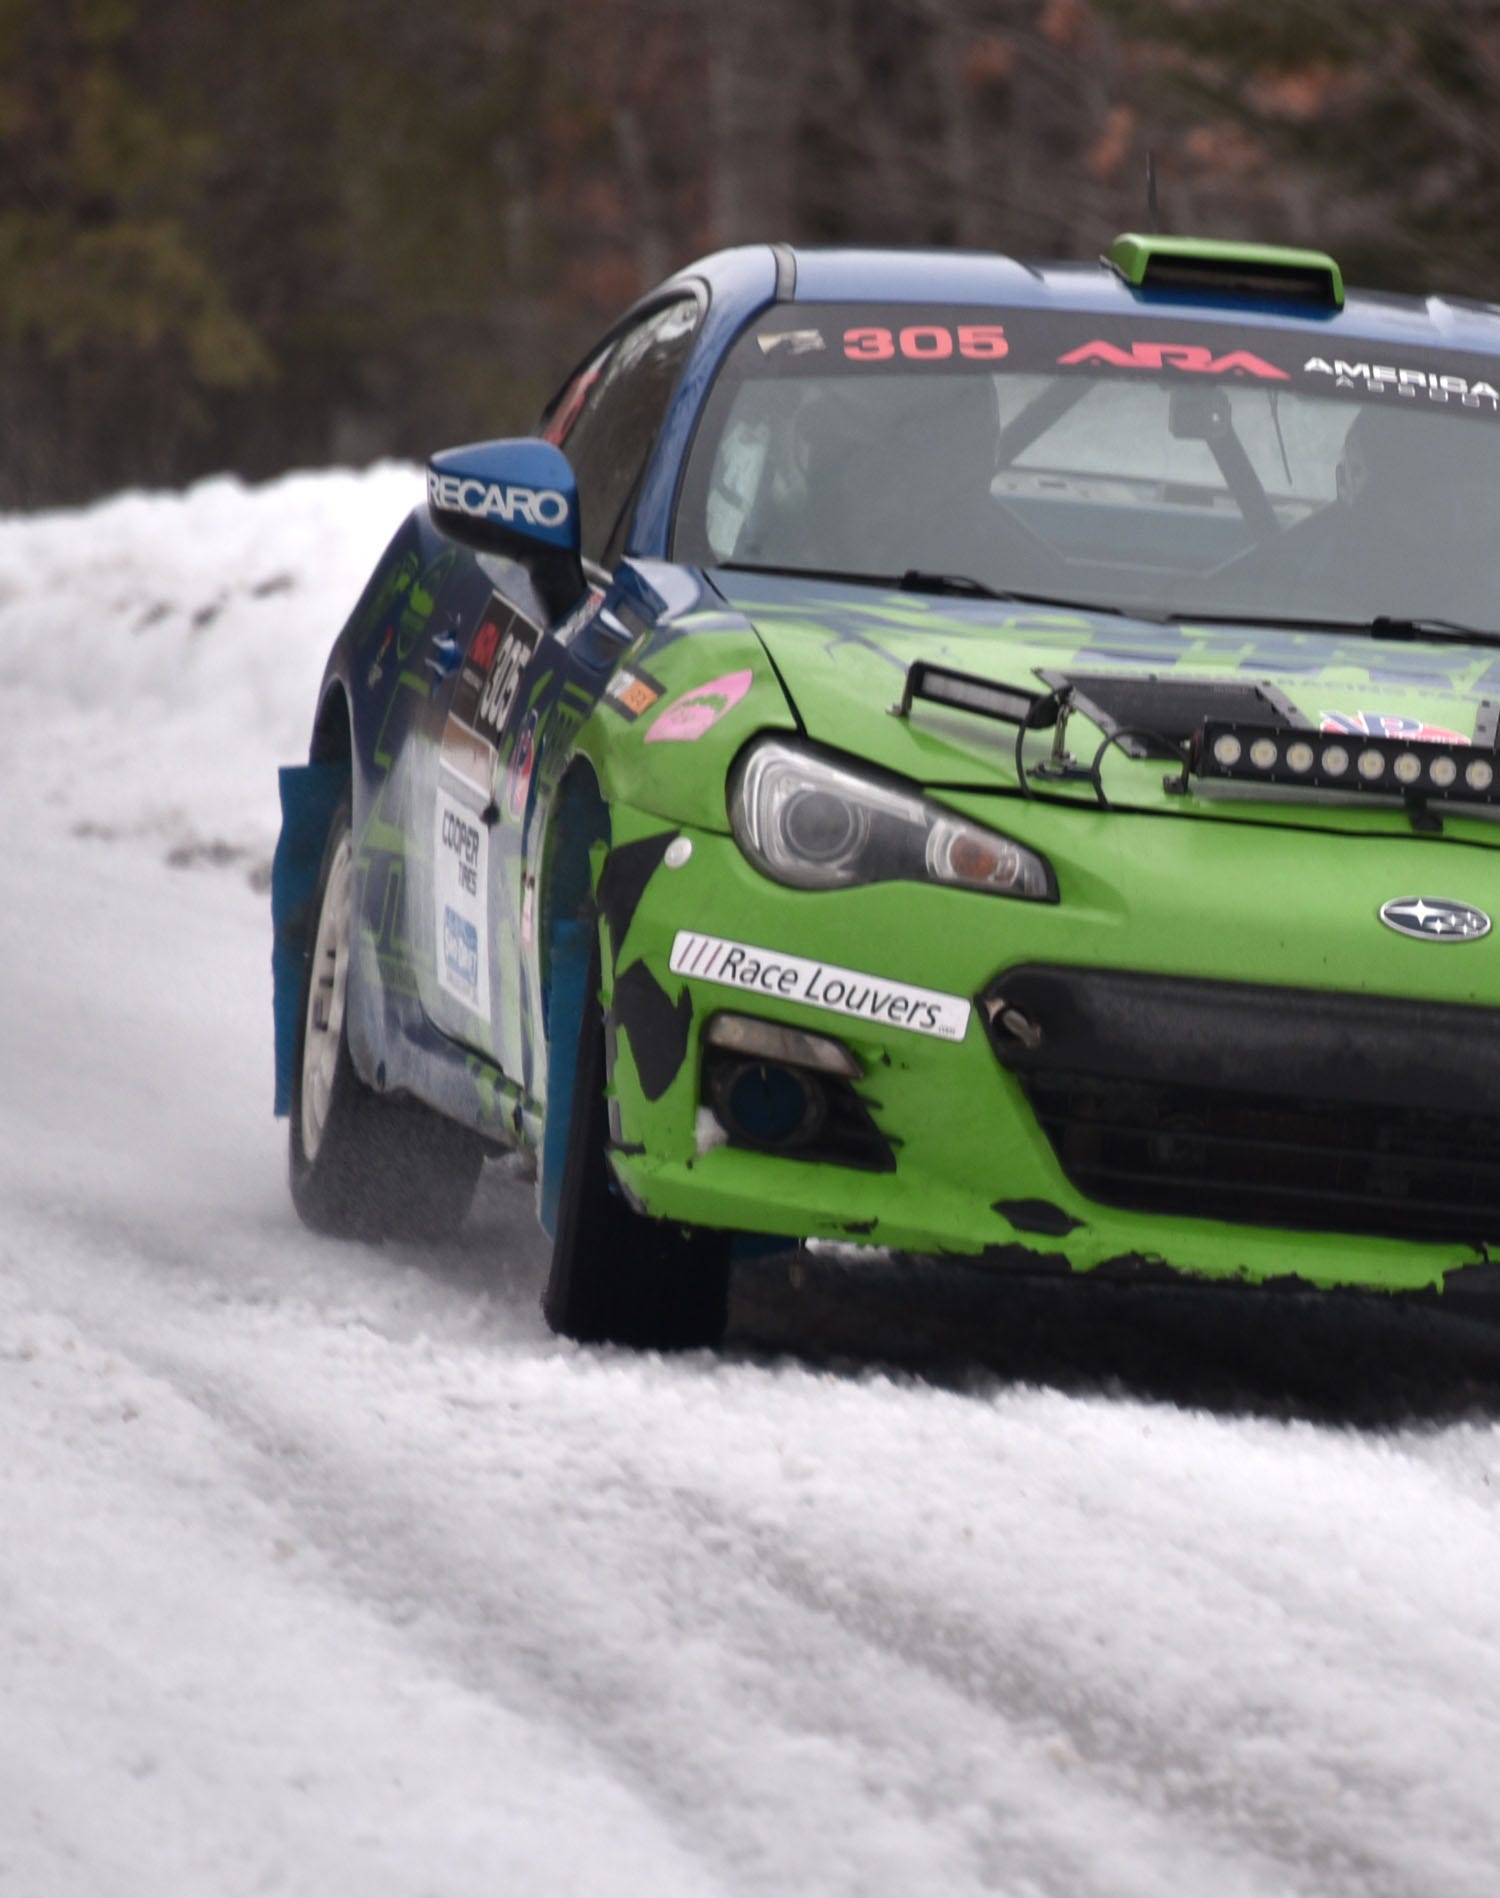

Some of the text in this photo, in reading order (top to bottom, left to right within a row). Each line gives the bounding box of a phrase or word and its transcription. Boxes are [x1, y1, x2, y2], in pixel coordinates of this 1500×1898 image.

[843, 325, 1291, 381] 305 ARA
[427, 471, 569, 527] RECARO
[441, 808, 480, 868] COOPER
[804, 967, 942, 1029] Louvers
